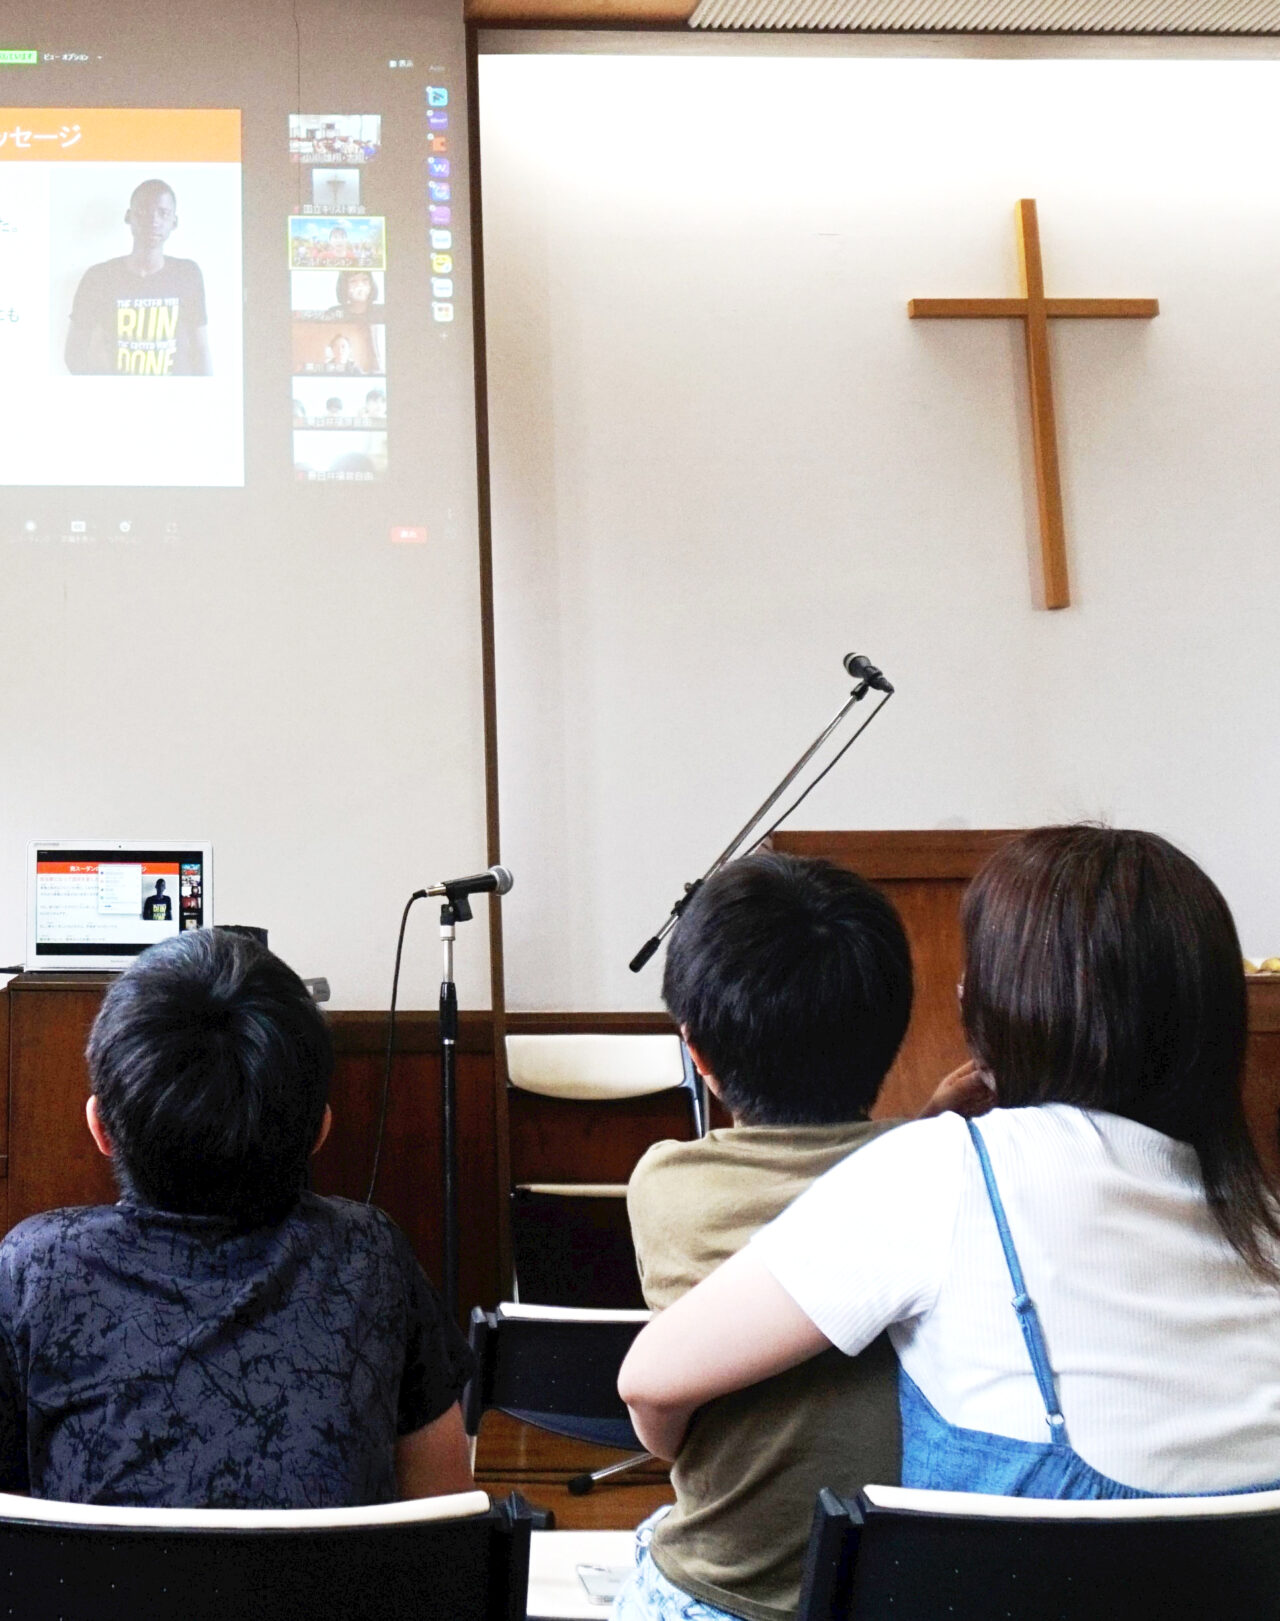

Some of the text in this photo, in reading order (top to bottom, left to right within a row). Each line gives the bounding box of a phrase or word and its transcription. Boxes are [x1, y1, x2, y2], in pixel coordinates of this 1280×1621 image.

[61, 53, 90, 62] オプション
[116, 306, 180, 341] RUN
[117, 347, 177, 376] DONE
